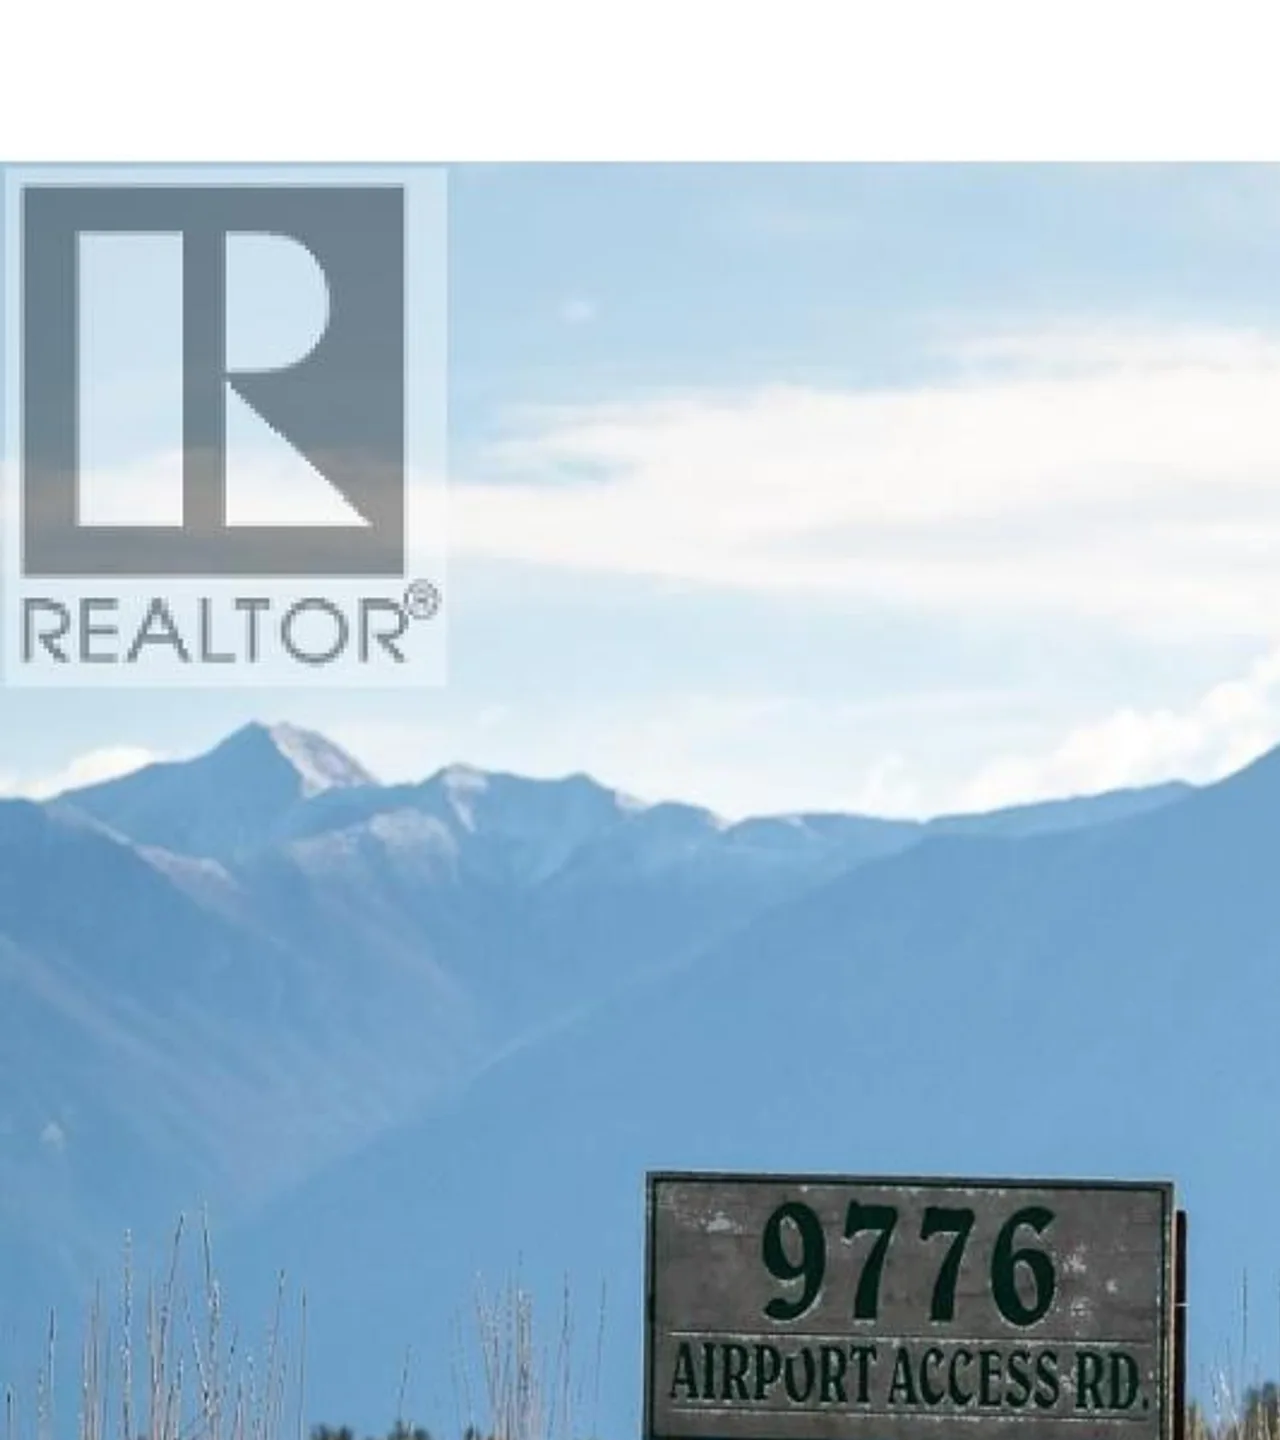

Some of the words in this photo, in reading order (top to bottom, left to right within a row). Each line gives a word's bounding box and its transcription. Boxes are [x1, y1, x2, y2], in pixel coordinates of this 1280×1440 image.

[762, 1200, 1057, 1327] 9776
[669, 1341, 877, 1403] AIRPORT
[888, 1345, 1060, 1409] ACCESS
[1074, 1349, 1150, 1411] RD.
